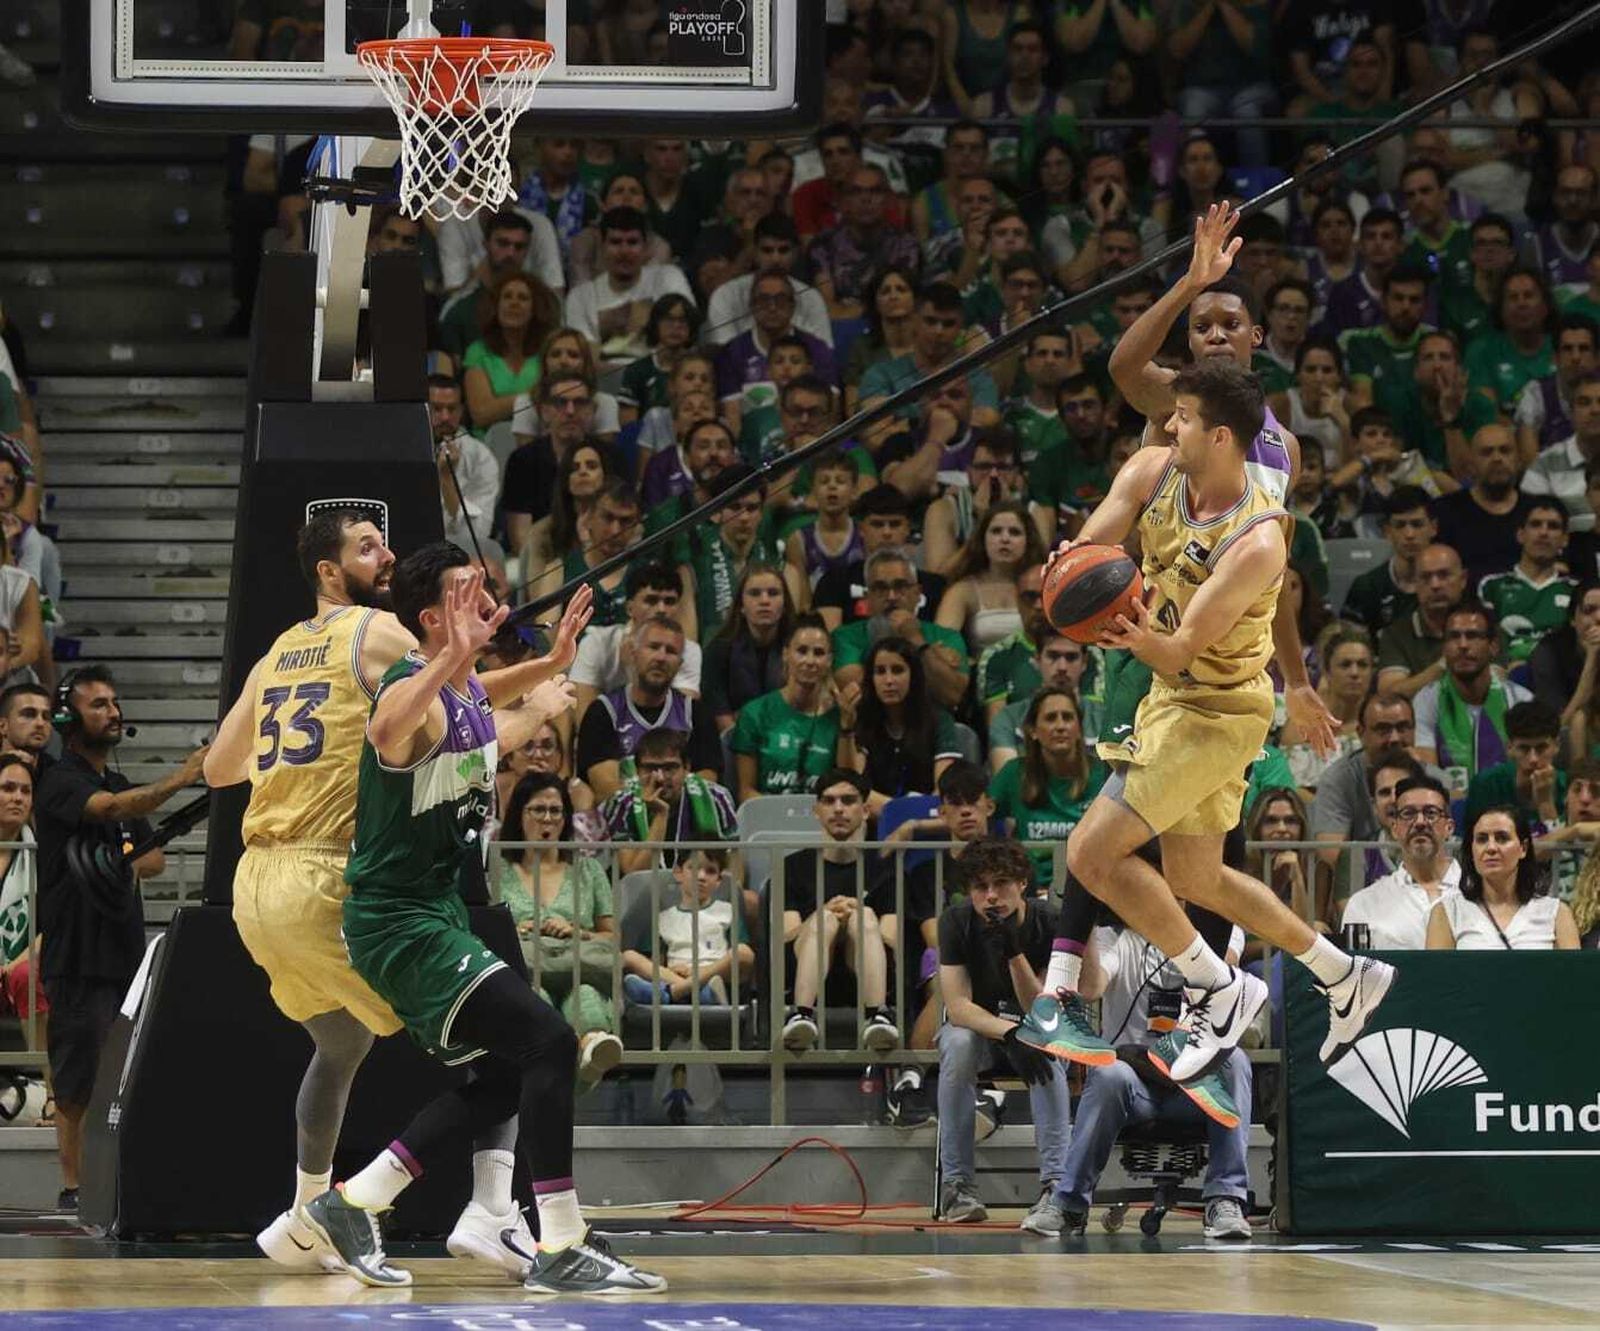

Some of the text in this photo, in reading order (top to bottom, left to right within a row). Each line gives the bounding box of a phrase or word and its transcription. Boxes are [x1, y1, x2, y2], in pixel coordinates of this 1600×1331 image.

[669, 22, 735, 35] PLAYOFF
[274, 636, 331, 672] MIROTIĆ
[257, 682, 330, 771] 33
[1475, 1092, 1600, 1132] Fund
